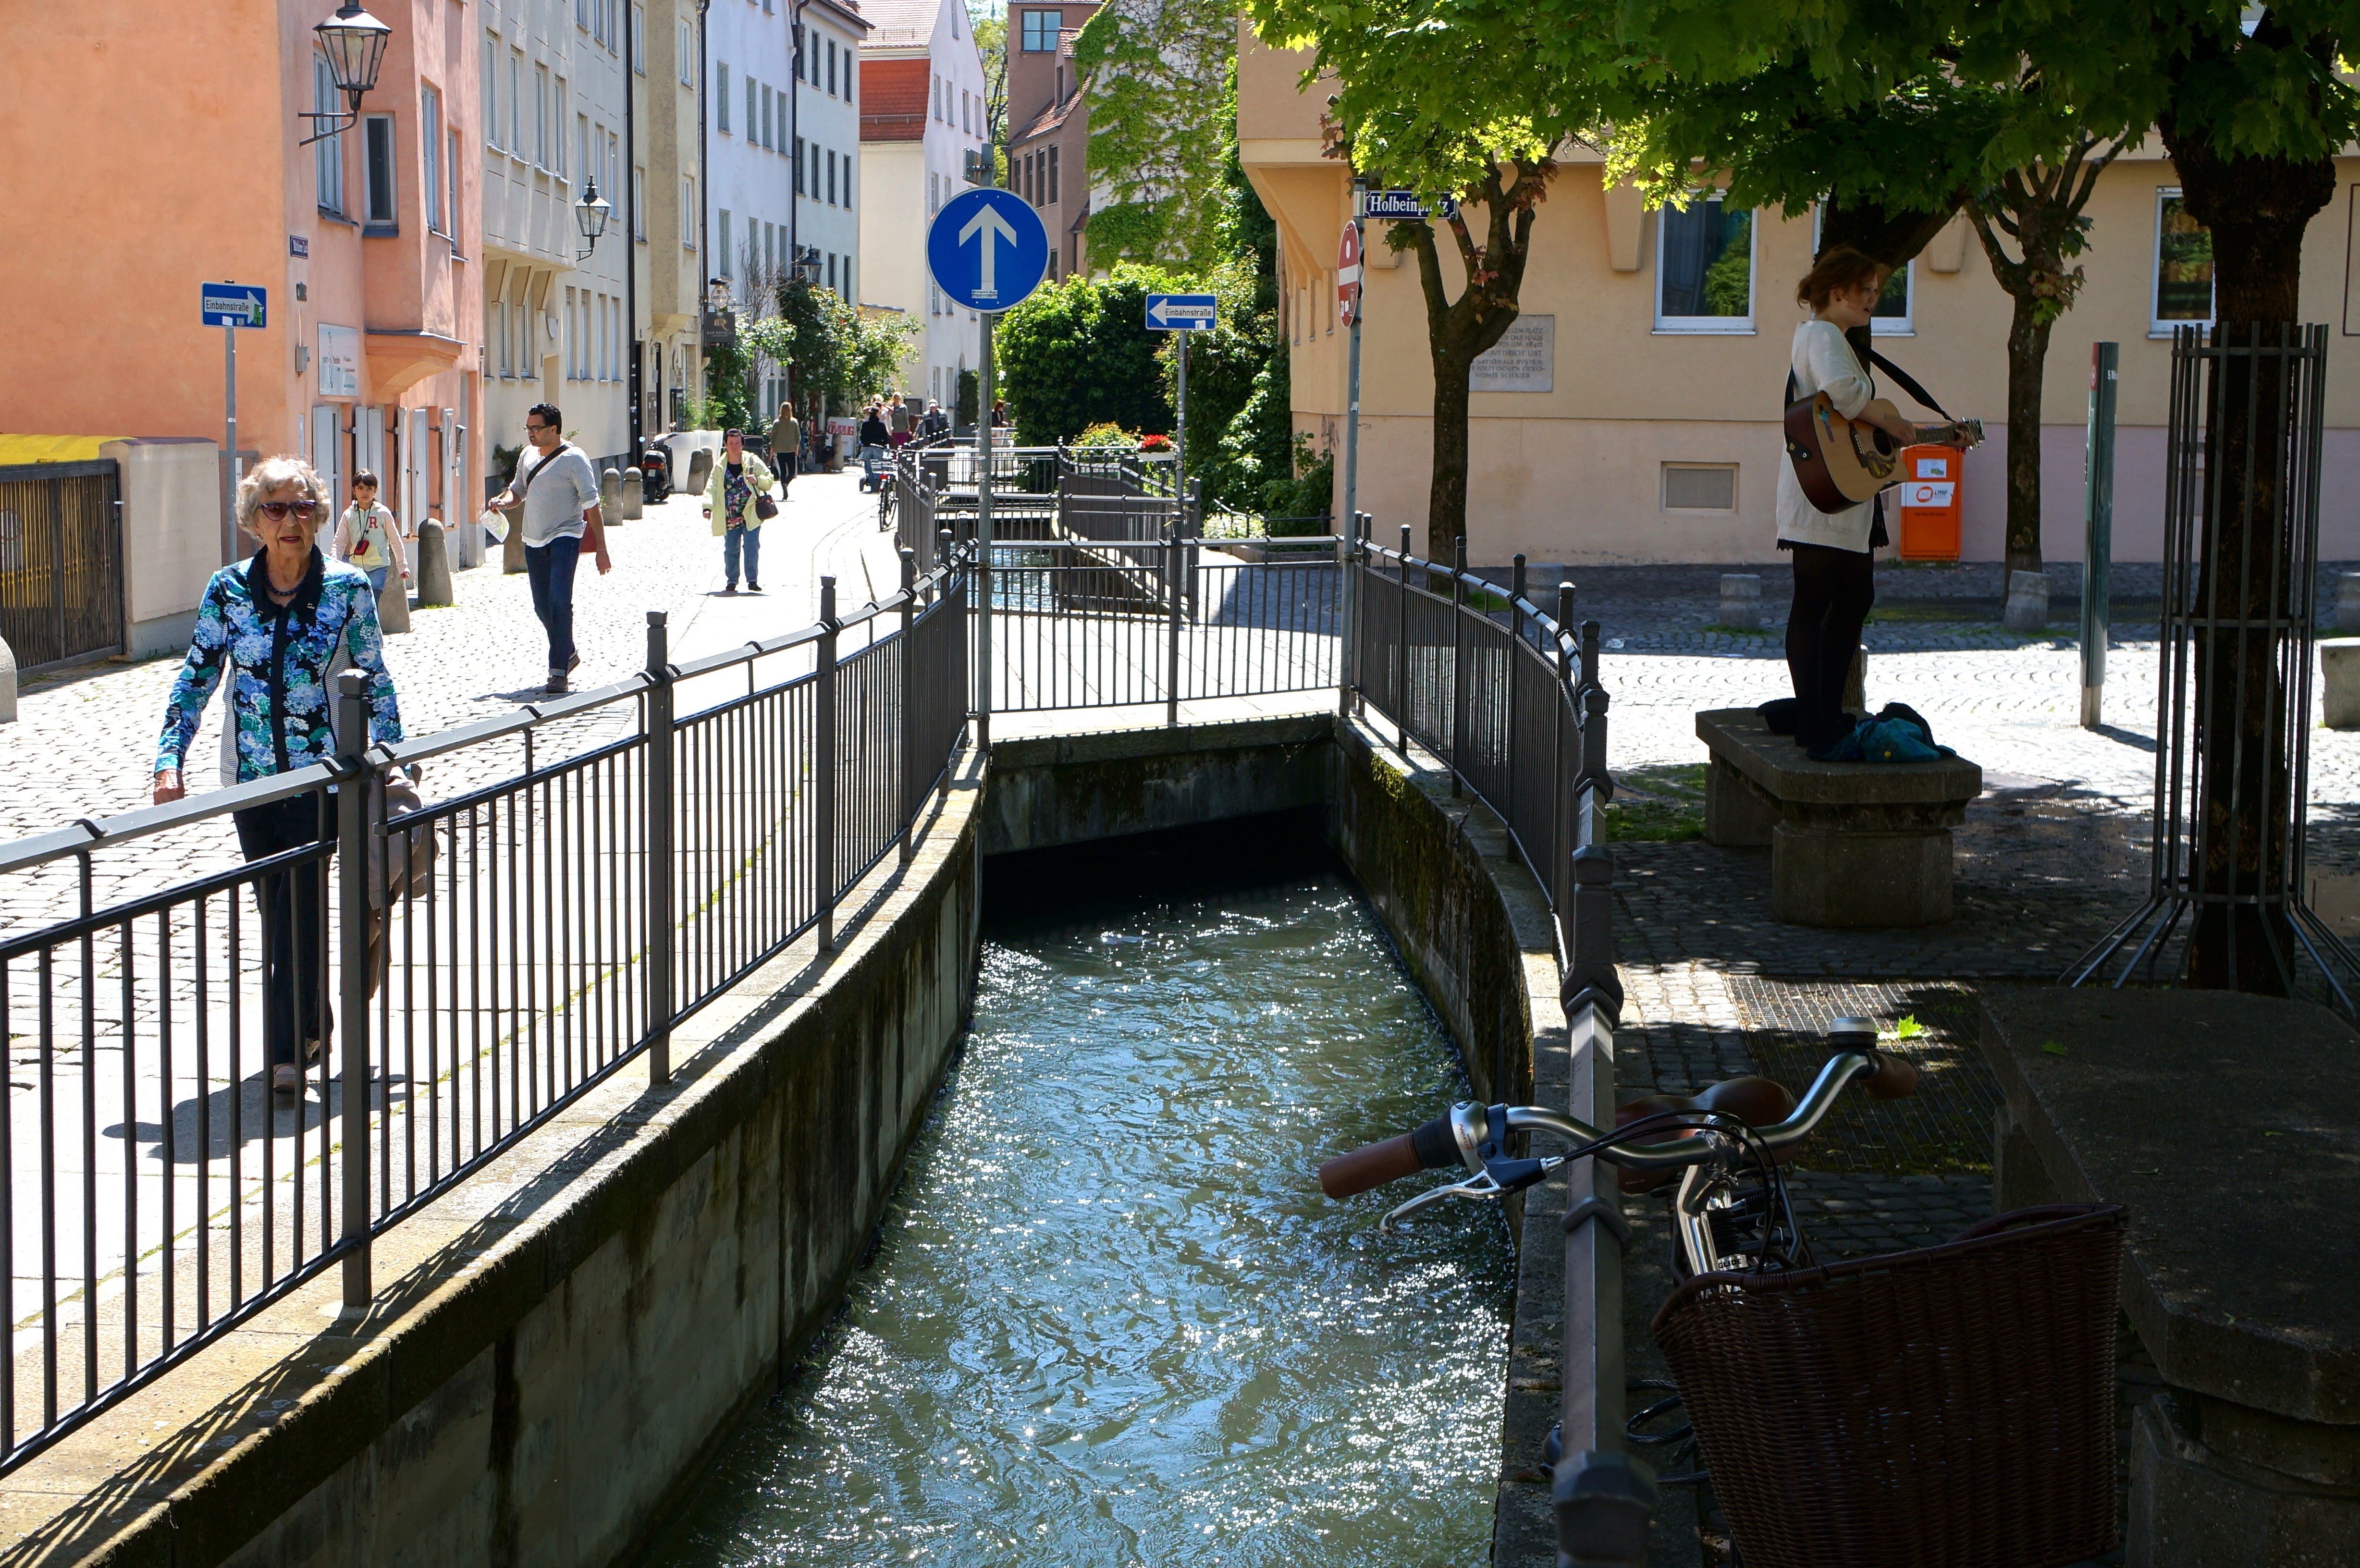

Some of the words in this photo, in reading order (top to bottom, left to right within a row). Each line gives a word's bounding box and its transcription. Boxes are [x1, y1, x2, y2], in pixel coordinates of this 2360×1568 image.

[206, 300, 249, 312] Einbahnstraße
[1165, 308, 1212, 317] Einbahnstraße
[369, 516, 379, 529] R
[1719, 1258, 1742, 1269] GLIDE
